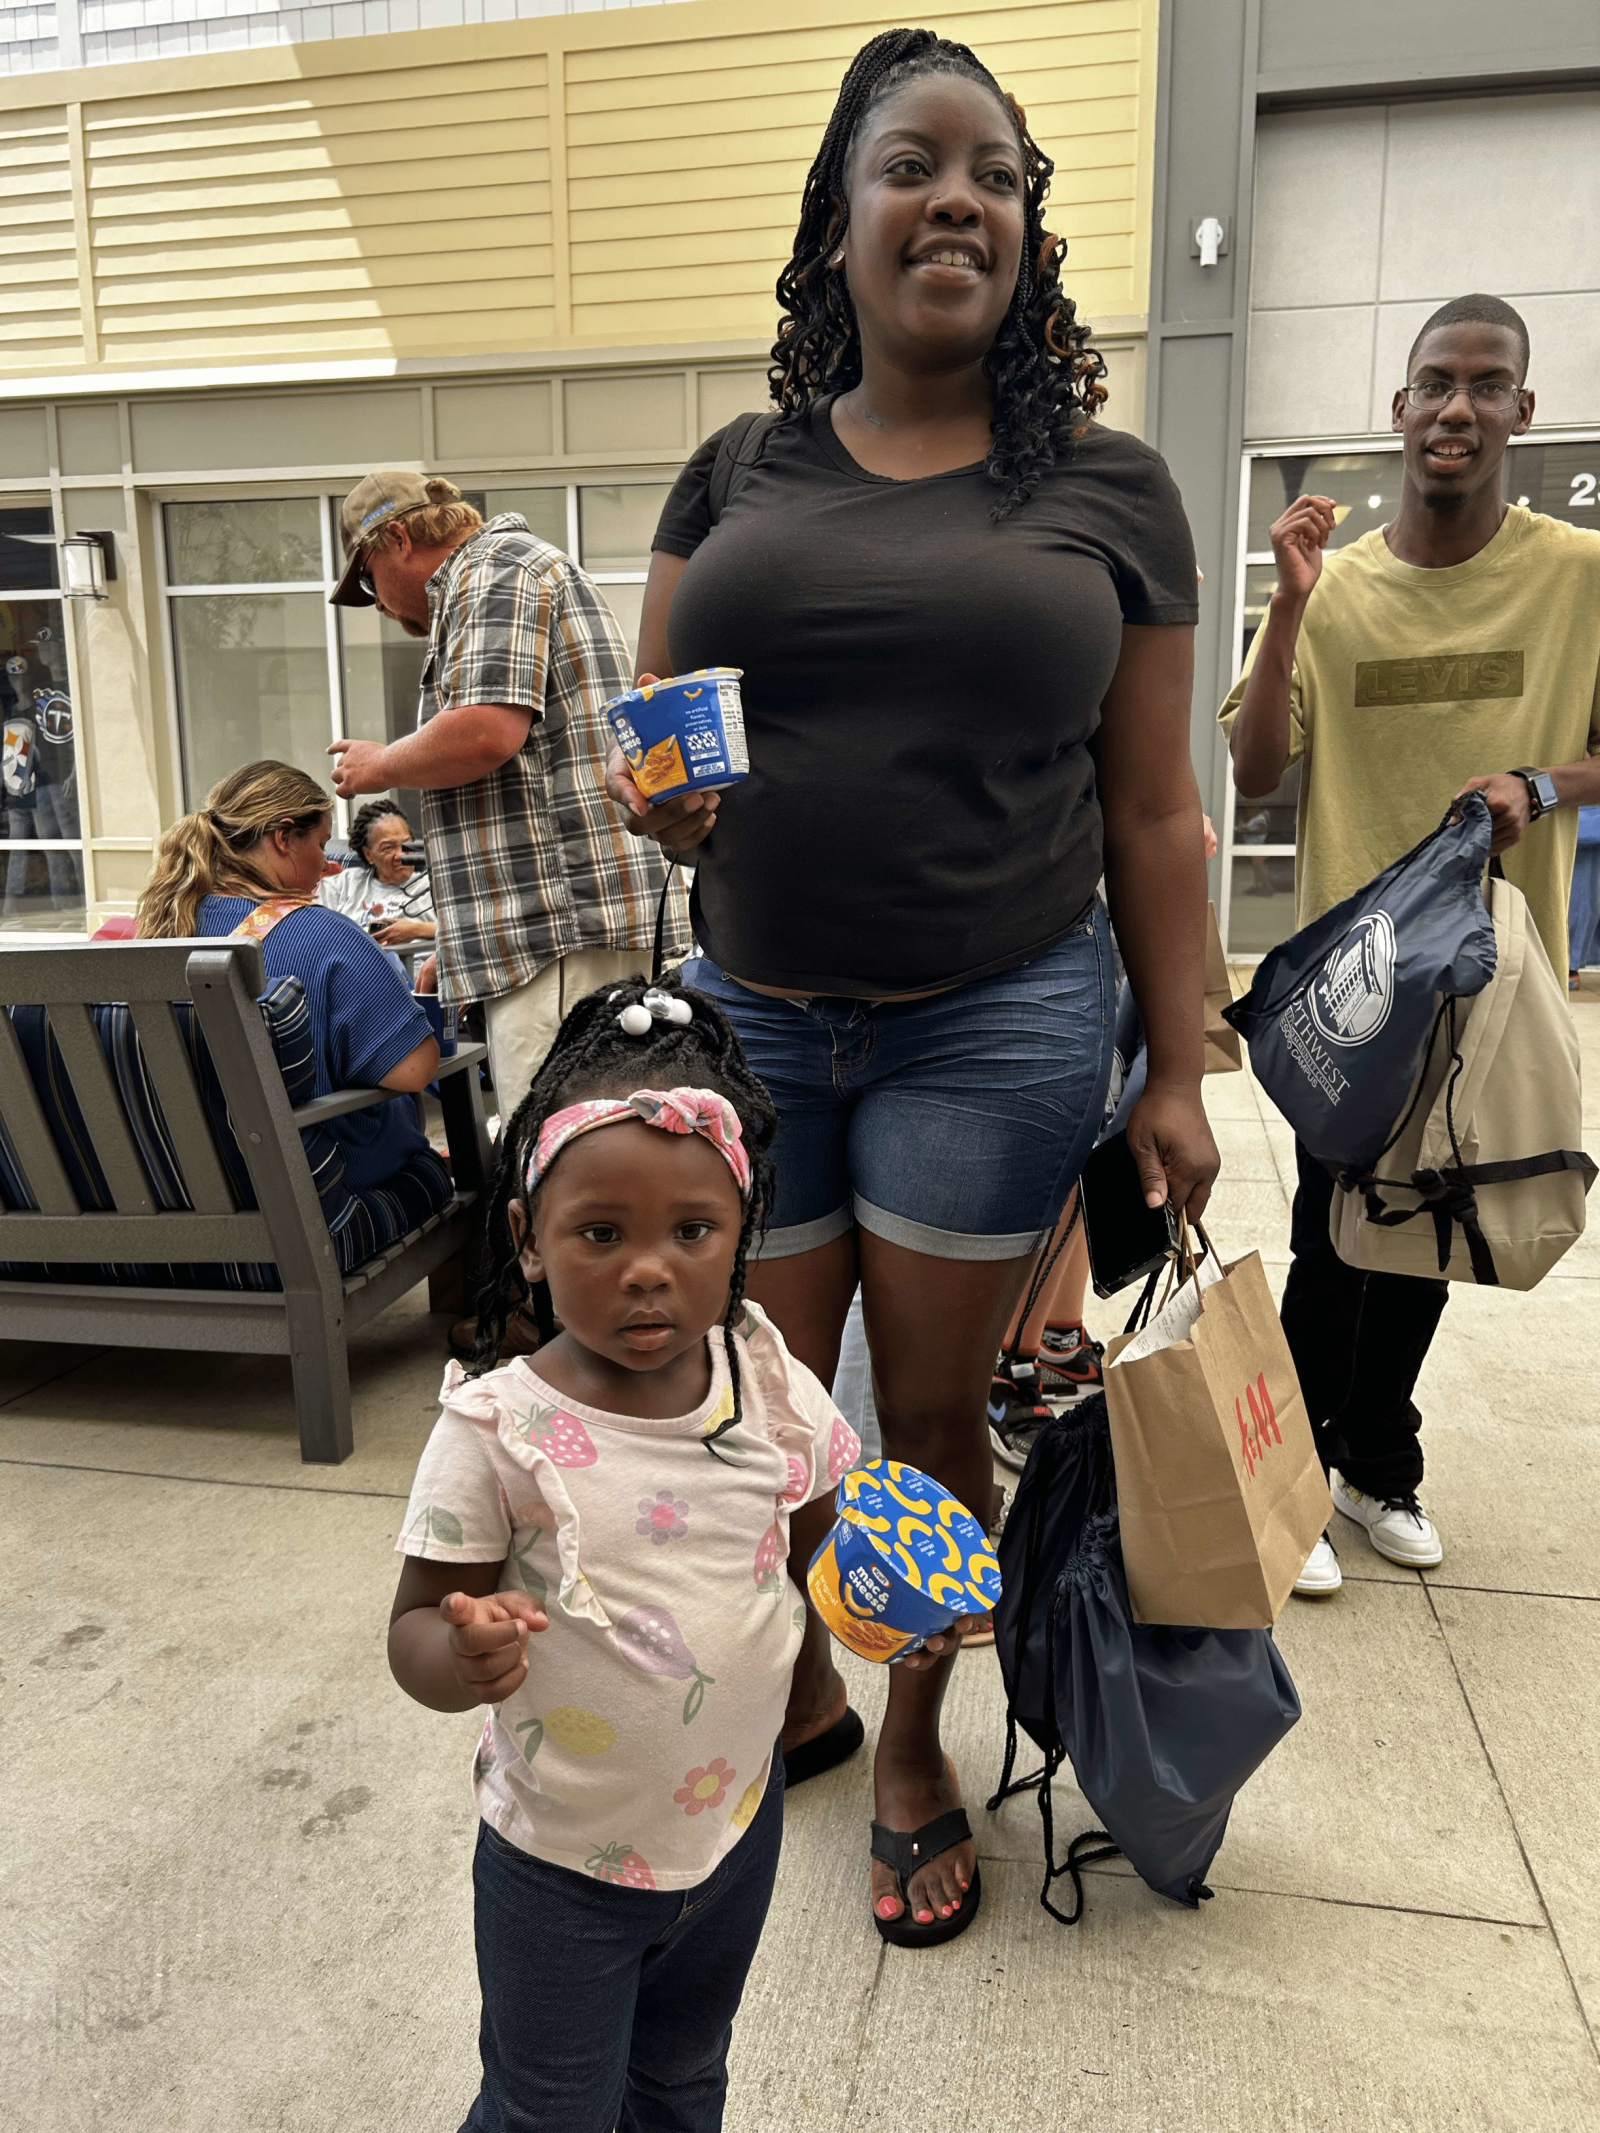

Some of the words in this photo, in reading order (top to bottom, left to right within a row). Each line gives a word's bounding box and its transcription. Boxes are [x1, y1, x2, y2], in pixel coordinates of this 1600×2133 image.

[1568, 473, 1600, 507] 2
[1367, 659, 1510, 700] LEVI'S
[1291, 1049, 1318, 1088] CAMPUS
[856, 1566, 881, 1595] mac
[878, 1592, 890, 1604] &
[873, 1567, 889, 1586] Kraft
